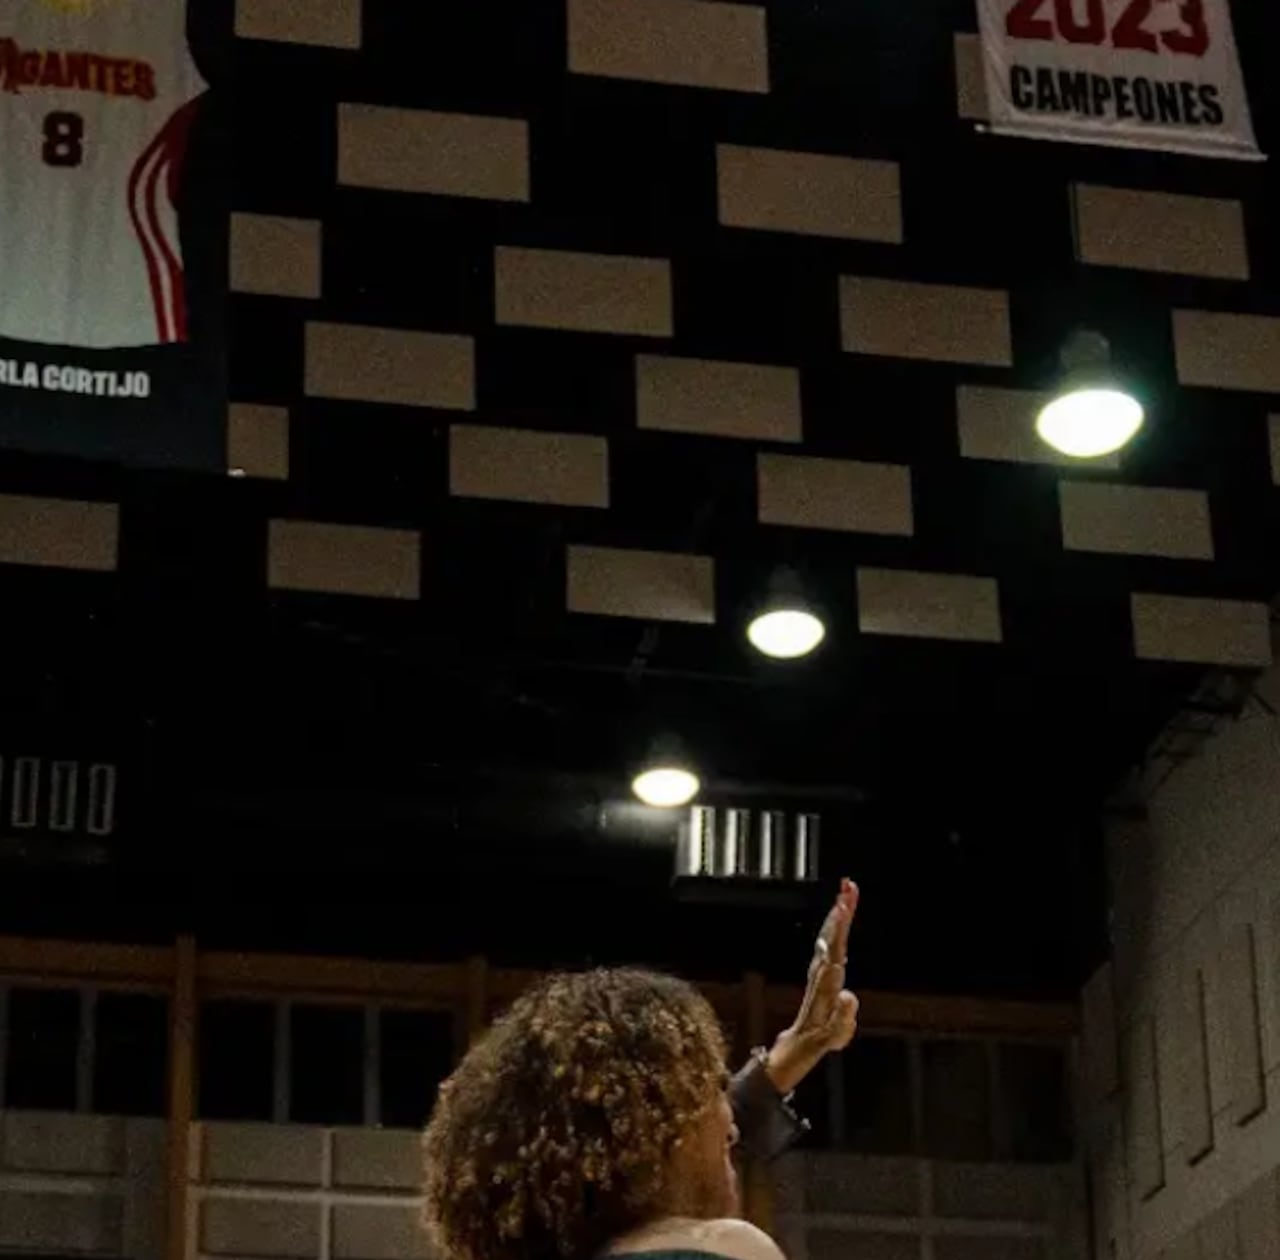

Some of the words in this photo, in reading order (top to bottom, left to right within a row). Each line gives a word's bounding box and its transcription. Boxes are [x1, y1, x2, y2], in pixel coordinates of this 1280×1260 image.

[1009, 64, 1224, 125] CAMPEONES
[41, 111, 84, 167] 8
[42, 364, 151, 398] CORTIJO
